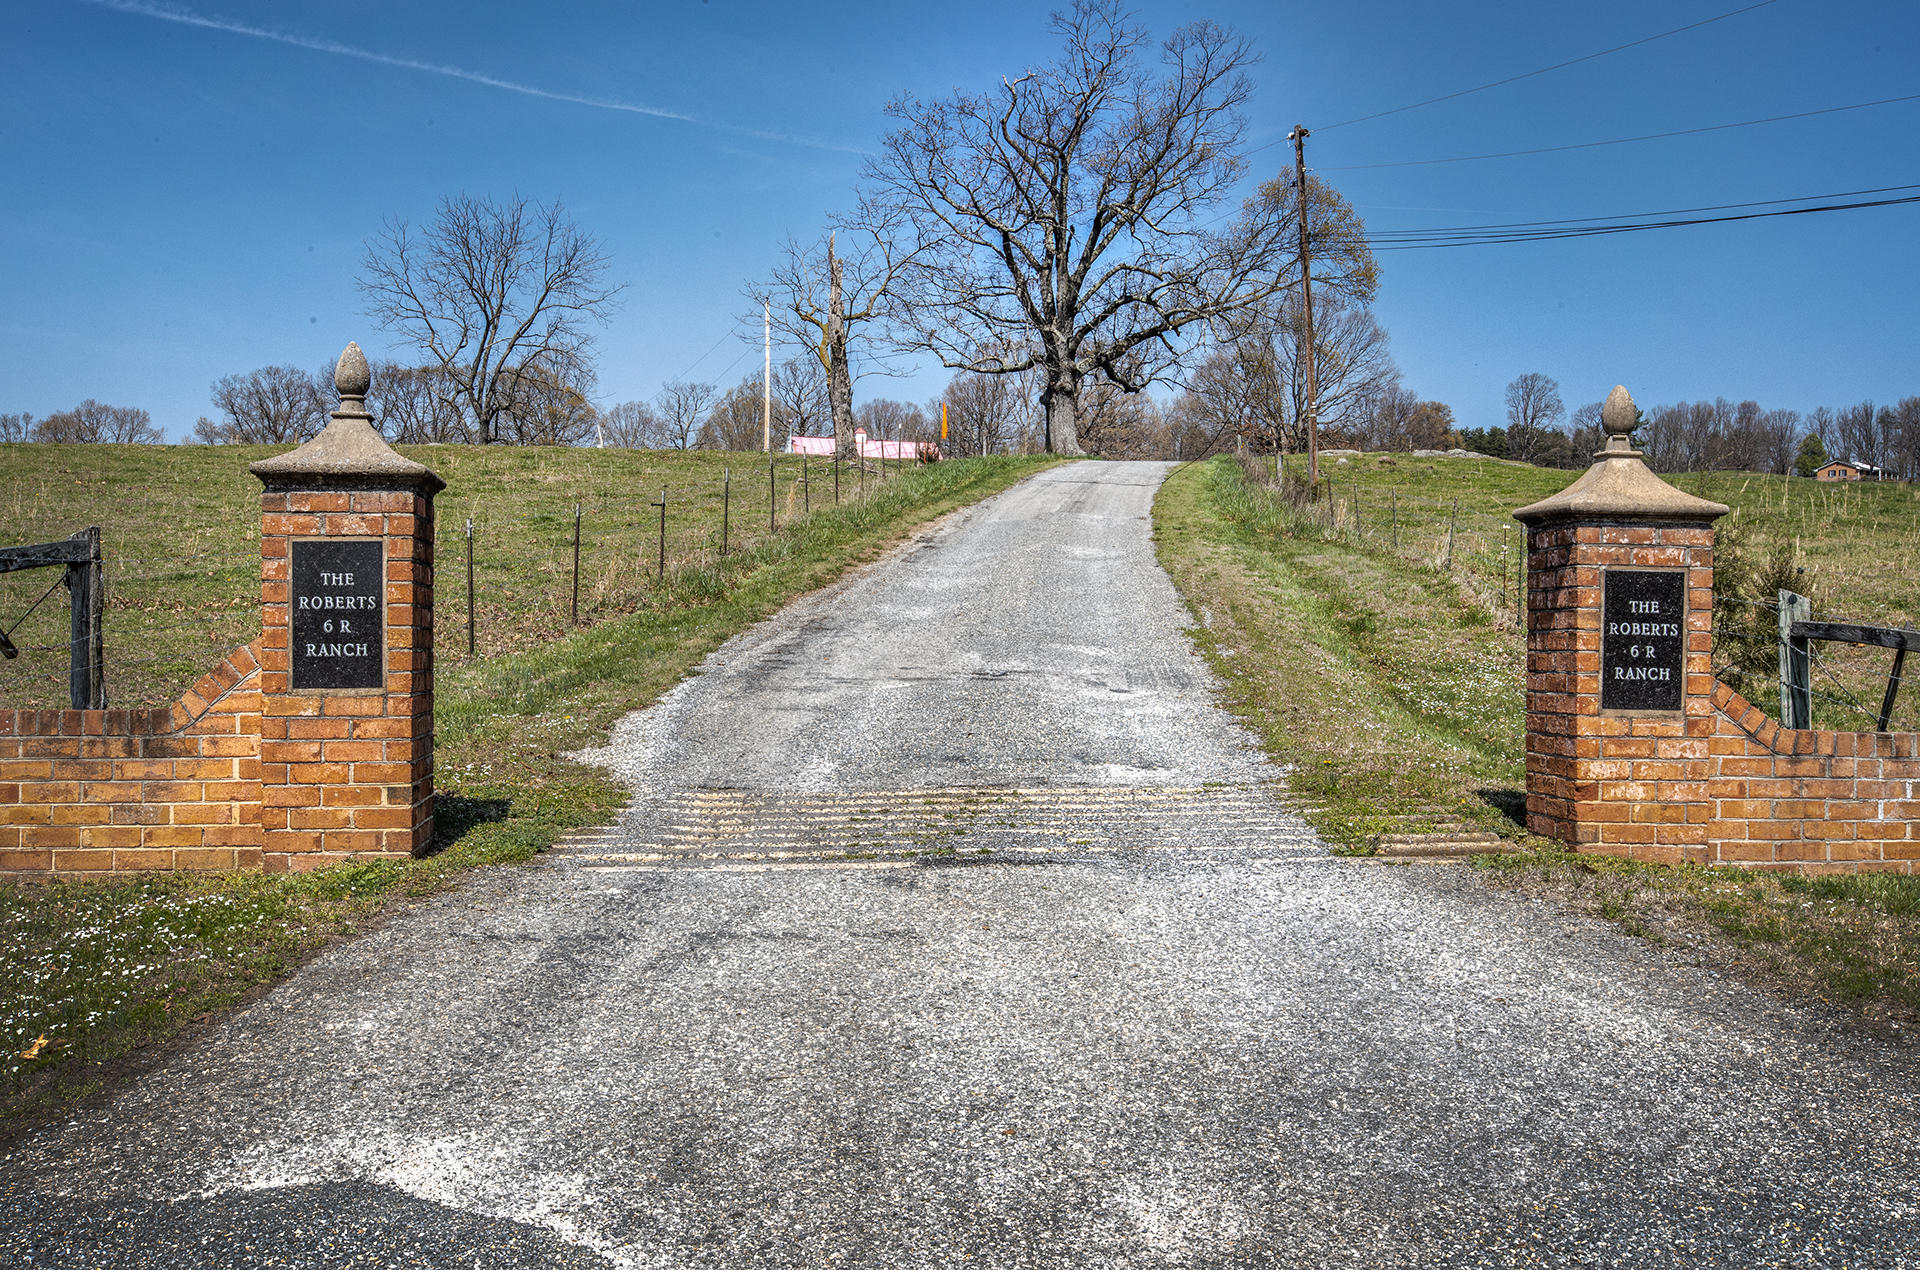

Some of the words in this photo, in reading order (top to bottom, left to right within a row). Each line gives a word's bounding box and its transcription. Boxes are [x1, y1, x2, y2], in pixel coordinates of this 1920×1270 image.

[320, 572, 355, 586] THE
[299, 596, 377, 610] ROBERTS
[1629, 600, 1660, 614] THE
[1609, 622, 1679, 637] ROBERTS
[305, 643, 368, 657] RANCH
[1614, 666, 1670, 681] RANCH
